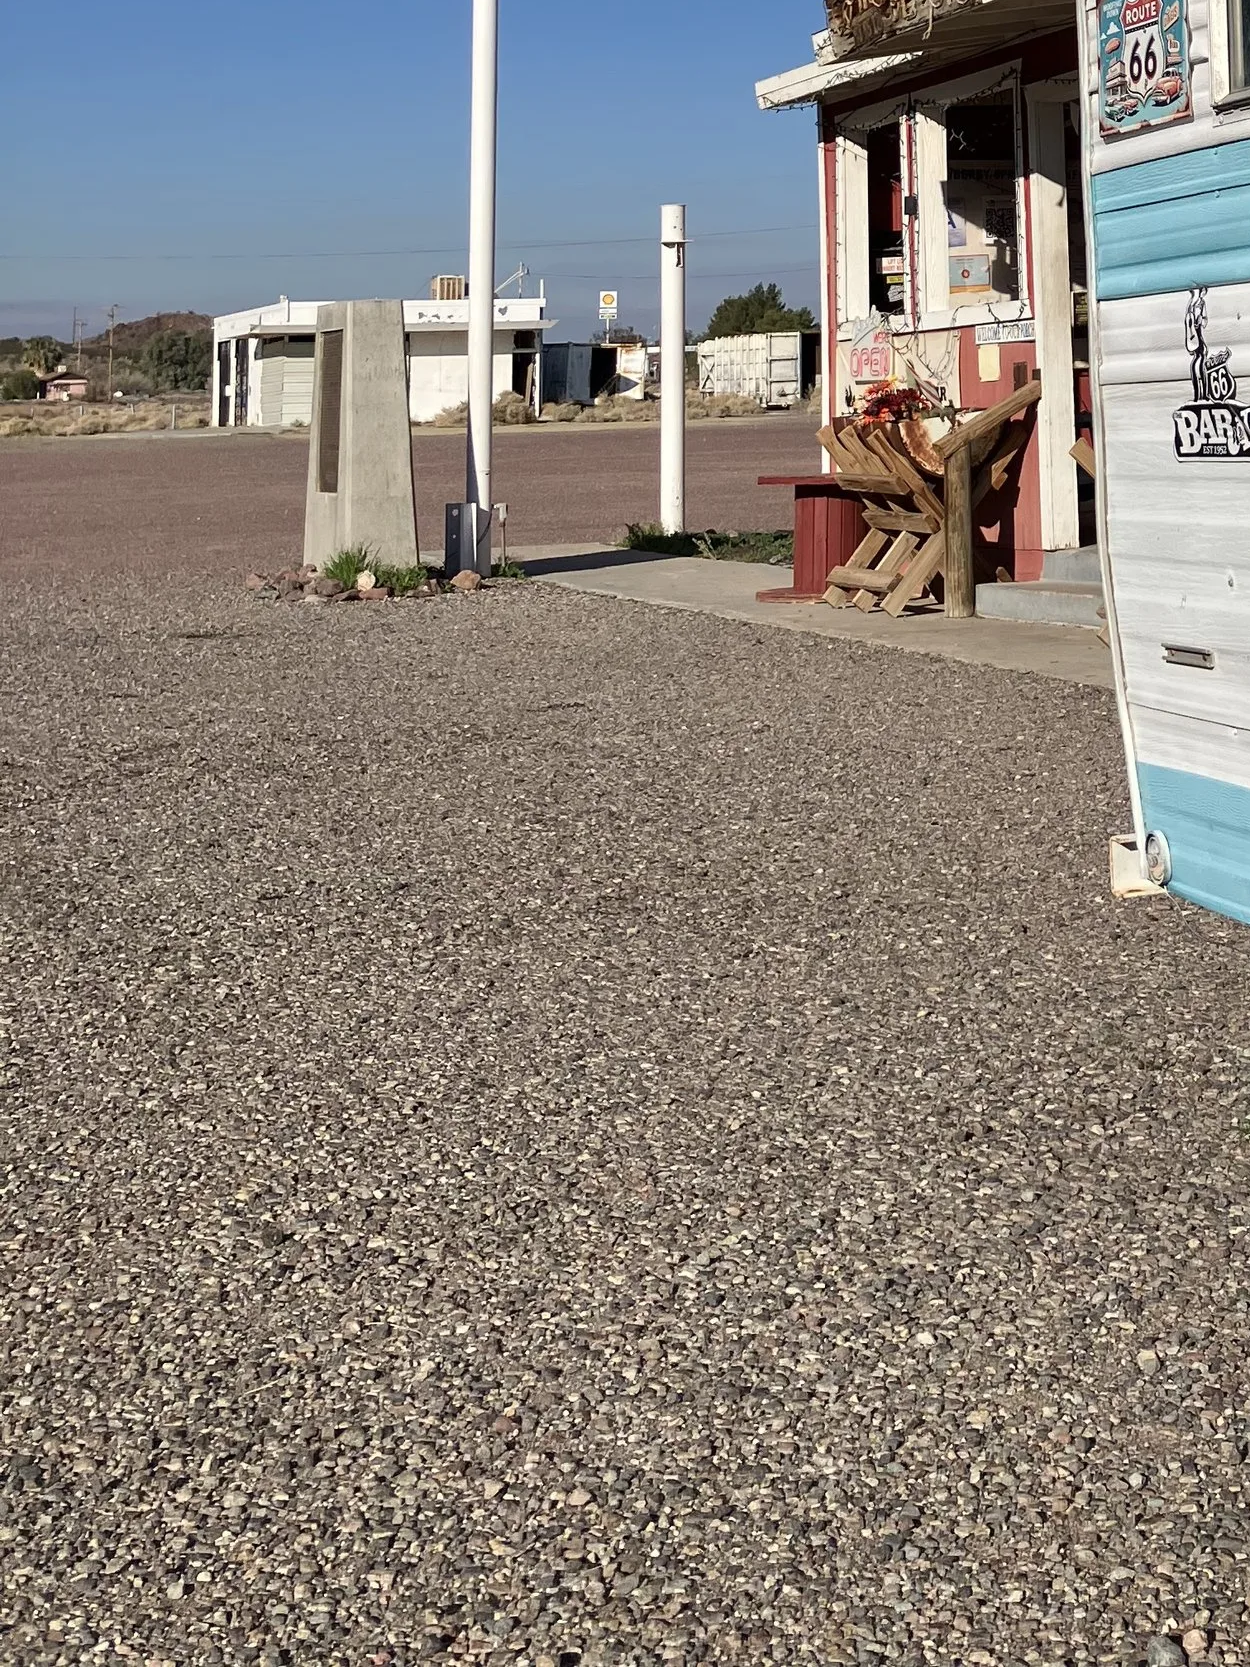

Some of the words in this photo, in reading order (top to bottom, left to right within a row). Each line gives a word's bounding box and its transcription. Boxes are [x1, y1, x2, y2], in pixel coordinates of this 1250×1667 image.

[1125, 1, 1157, 25] ROUTE
[1129, 35, 1158, 84] 66
[851, 346, 890, 378] OPEN
[1210, 368, 1229, 399] 66
[1202, 445, 1213, 454] EST
